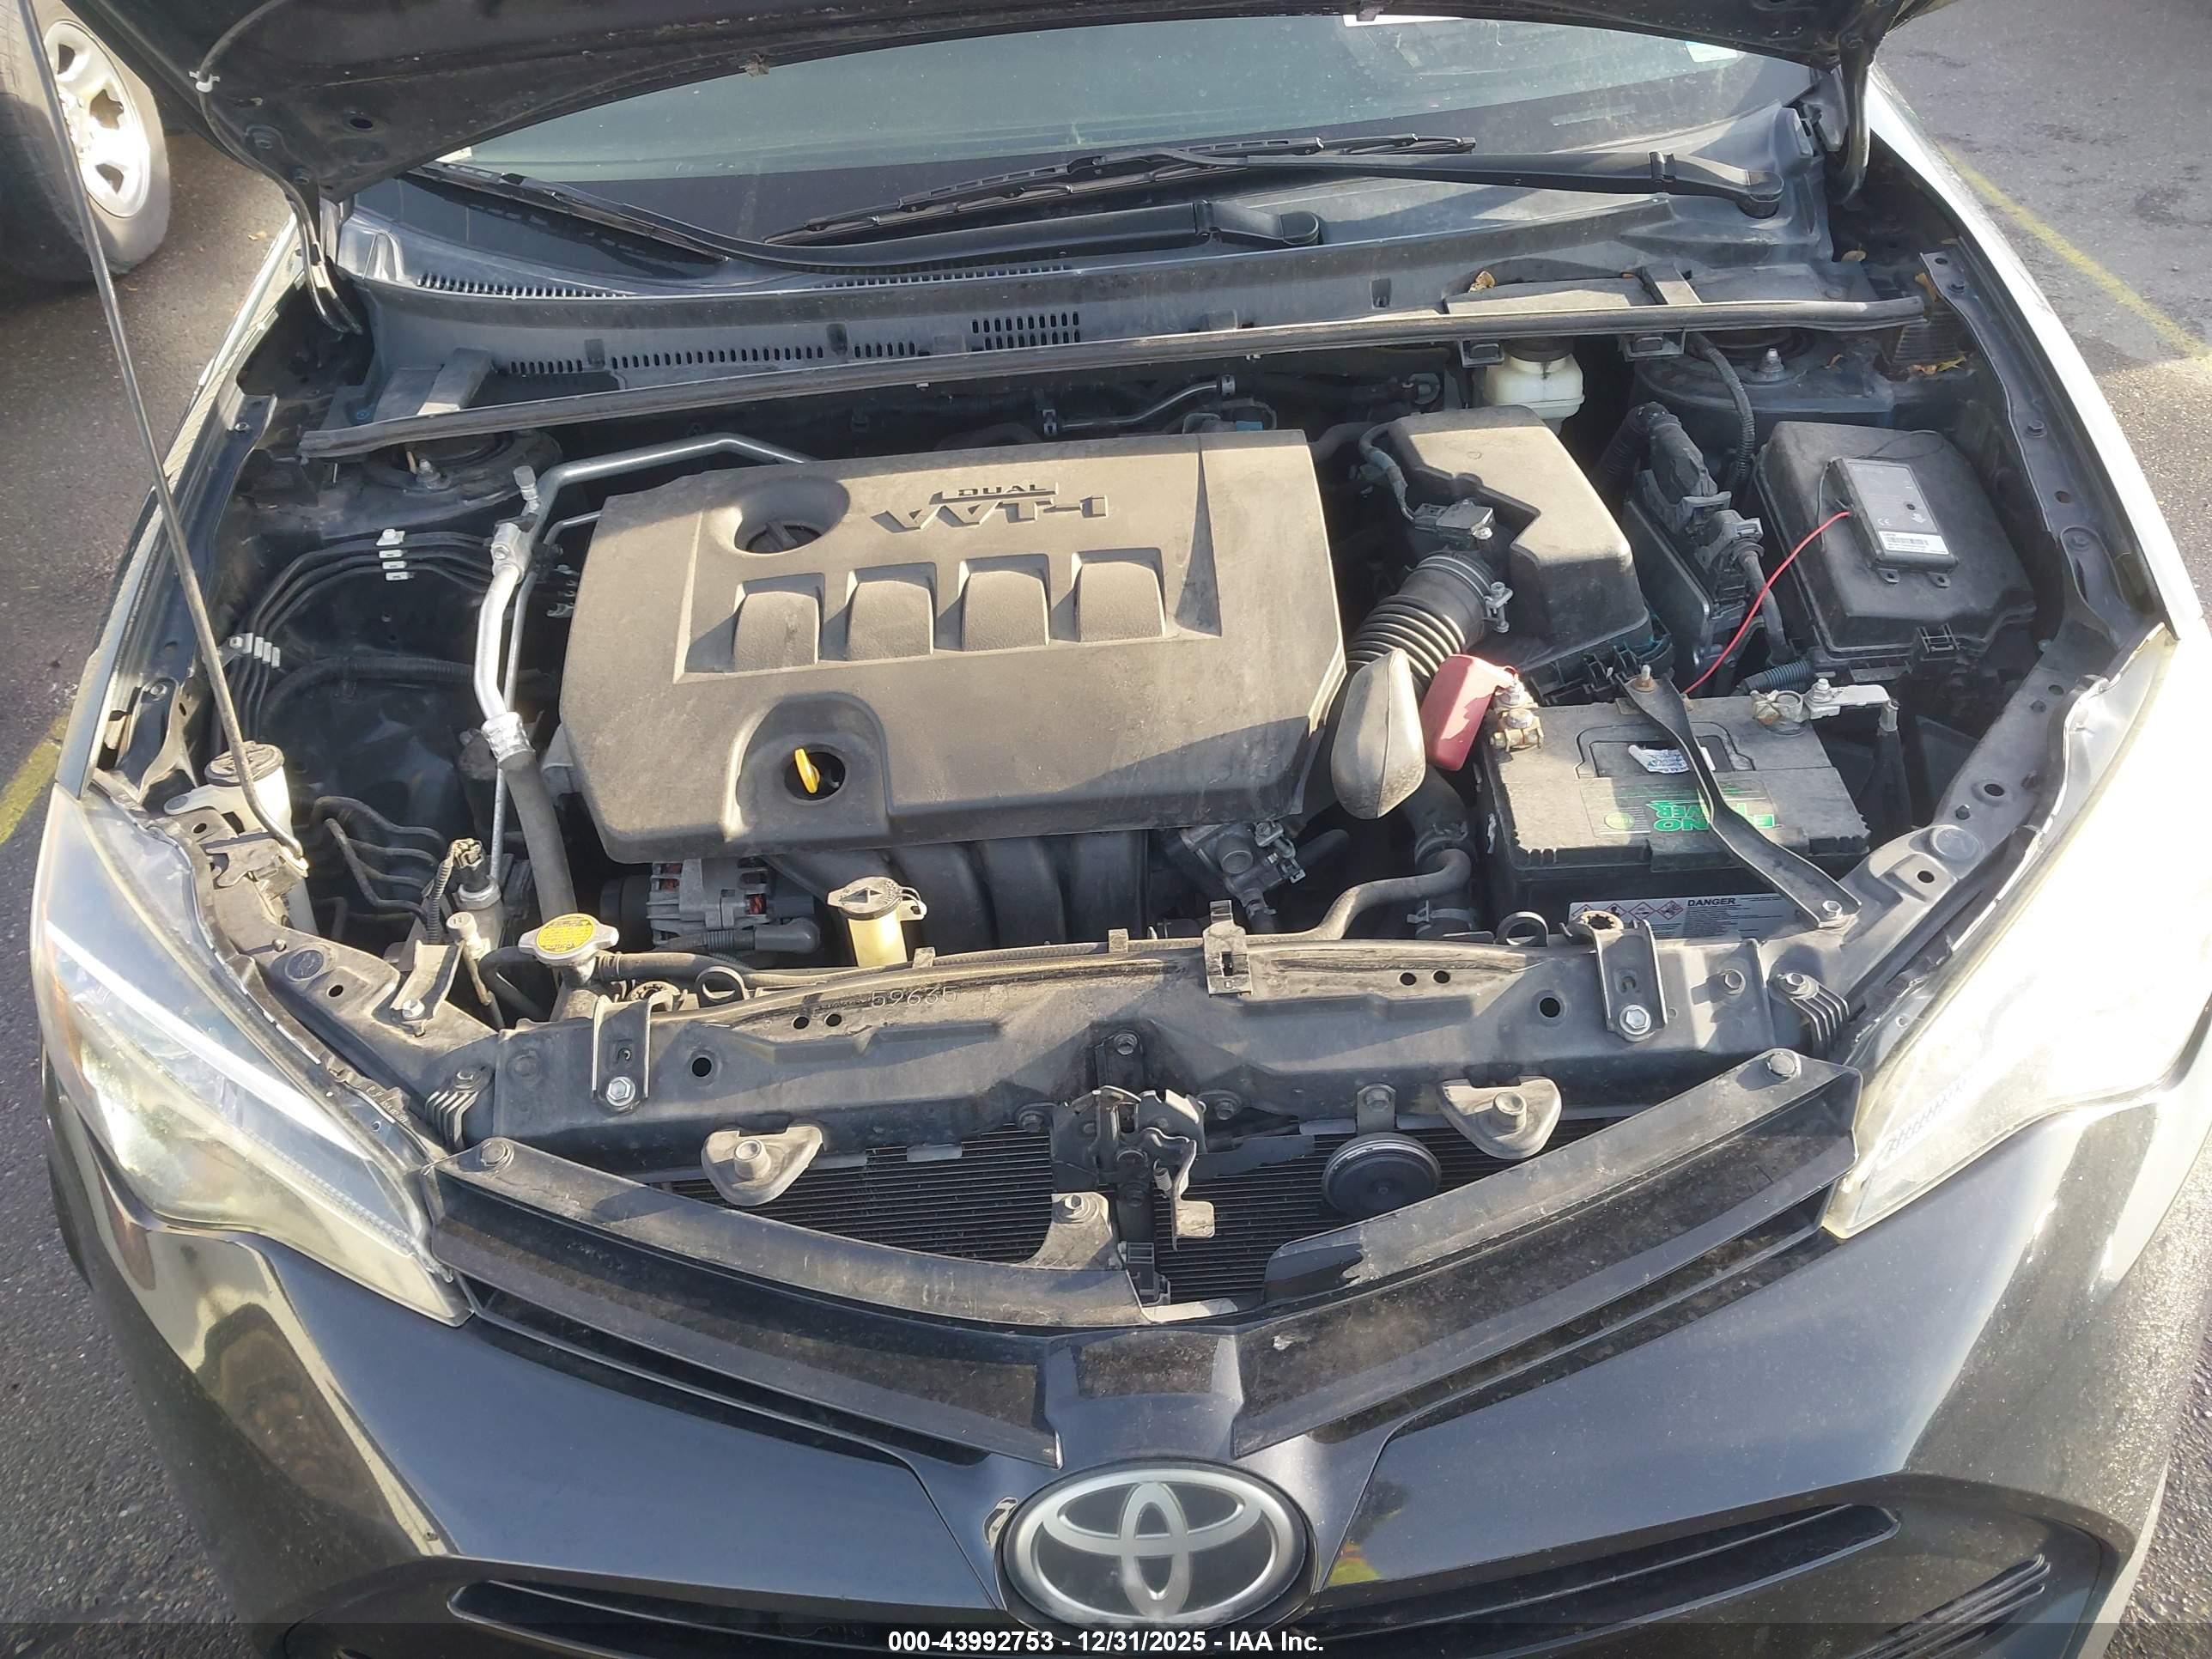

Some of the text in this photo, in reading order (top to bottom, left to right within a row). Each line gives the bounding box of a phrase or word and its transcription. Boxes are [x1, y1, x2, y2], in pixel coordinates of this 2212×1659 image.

[958, 484, 1047, 496] DUAL
[1687, 896, 1736, 907] DANGER
[871, 985, 959, 1009] 59635
